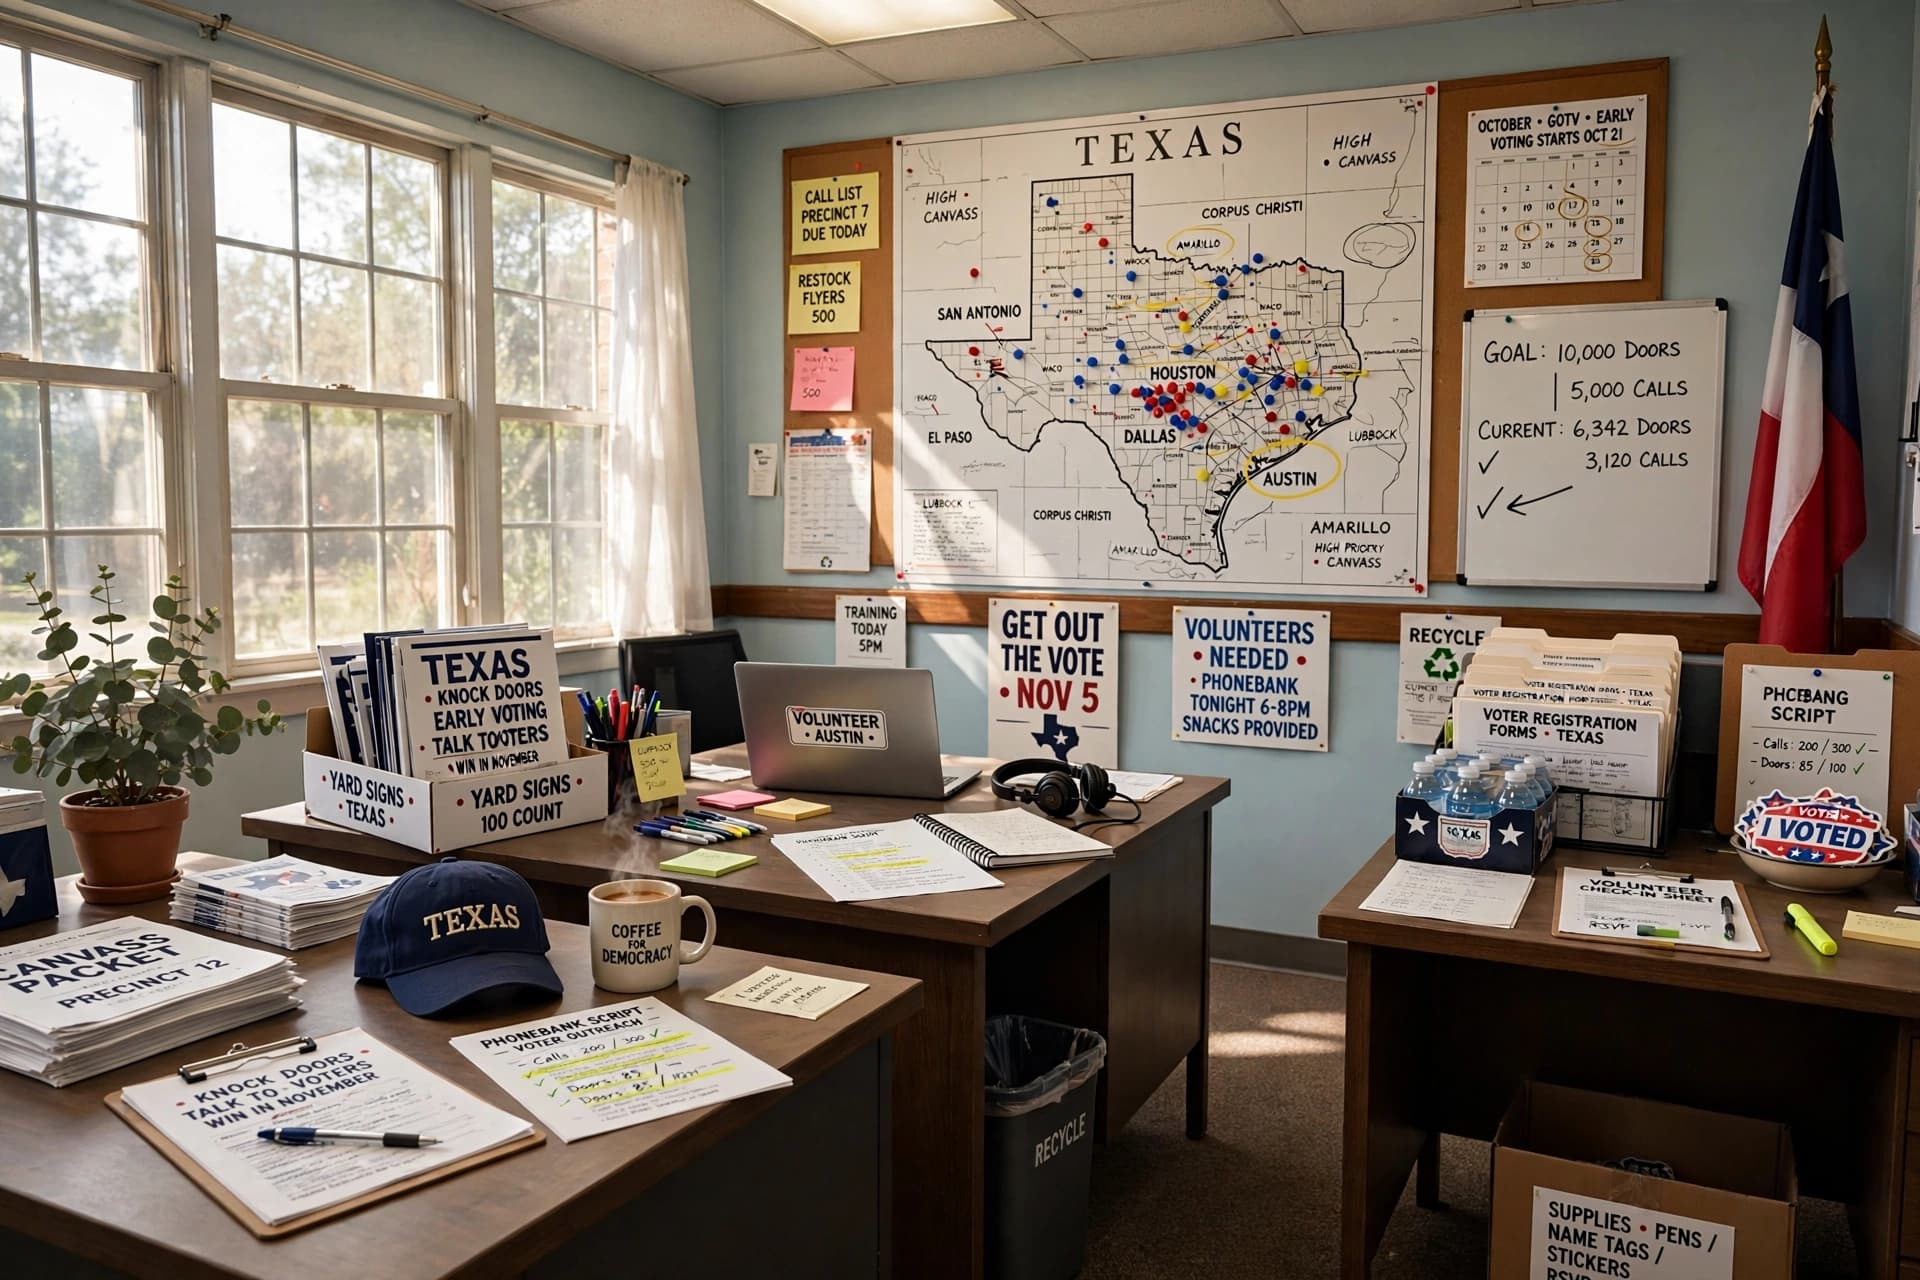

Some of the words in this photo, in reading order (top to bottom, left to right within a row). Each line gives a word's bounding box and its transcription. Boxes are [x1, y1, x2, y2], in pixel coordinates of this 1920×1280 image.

[1478, 116, 1532, 133] OCTOBER
[1548, 112, 1580, 128] GOTV
[1596, 108, 1634, 124] EARLY
[1075, 121, 1243, 167] TEXAS
[1333, 132, 1372, 150] HIGH
[1490, 134, 1534, 150] VOTING
[1537, 131, 1580, 148] STARTS
[1584, 130, 1606, 144] OCT
[1610, 128, 1622, 141] 21
[1338, 152, 1396, 168] CANVASS
[806, 188, 833, 204] CALL
[838, 186, 862, 201] LIST
[926, 190, 956, 206] HIGH
[801, 206, 858, 223] PRECINCT
[860, 204, 868, 218] 7
[924, 208, 978, 224] CANVASS
[1202, 204, 1250, 220] CORPUS
[1256, 200, 1304, 216] CHRISTI
[802, 226, 826, 242] DUE
[828, 223, 868, 239] TODAY
[1176, 238, 1220, 250] AMARILLO
[1520, 261, 1531, 269] 30
[798, 272, 850, 288] RESTOCK
[802, 290, 844, 306] FLYERS
[812, 308, 836, 324] 500
[938, 306, 962, 320] SAN
[966, 304, 1022, 320] ANTONIO
[1484, 340, 1546, 364] GOAL:
[1558, 342, 1616, 365] 10,000
[1624, 340, 1680, 360] DOORS
[1150, 364, 1216, 380] HOUSTON
[1570, 380, 1625, 402] 5,000
[1633, 378, 1688, 398] CALLS
[928, 432, 941, 444] EL
[944, 431, 972, 444] PASO
[1124, 428, 1176, 444] DALLAS
[1348, 430, 1398, 442] LUBBOCK
[1478, 420, 1564, 440] CURRENT:
[1572, 418, 1630, 441] 6,342
[1637, 418, 1692, 436] DOORS
[1585, 451, 1632, 473] 3,120
[1640, 450, 1688, 468] CALLS
[1262, 471, 1318, 486] AUSTIN
[1033, 510, 1072, 520] CORPUS
[1074, 510, 1112, 521] CHRISTI
[1310, 520, 1391, 534] AMARILLO
[1314, 542, 1342, 553] HIGH
[1327, 557, 1382, 568] CANVASS
[844, 606, 898, 620] TRAINING
[852, 622, 888, 636] TODAY
[1002, 609, 1048, 640] GET
[1054, 610, 1105, 643] OUT
[1184, 617, 1315, 646] VOLUNTEERS
[858, 640, 883, 654] 5PM
[1409, 627, 1486, 647] RECYCLE
[420, 648, 530, 686] TEXAS
[1000, 643, 1042, 673] THE
[1047, 646, 1104, 677] VOTE
[1209, 645, 1290, 671] NEEDED
[438, 686, 490, 706] KNOCK
[494, 681, 544, 702] DOORS
[1202, 673, 1299, 696] PHONEBANK
[1017, 677, 1073, 712] NOV
[1080, 681, 1099, 714] 5
[1190, 694, 1256, 715] TONIGHT
[1260, 697, 1311, 718] 6-8PM
[434, 708, 485, 732] EARLY
[492, 701, 548, 724] VOTING
[792, 710, 880, 730] VOLUNTEER
[1483, 707, 1529, 724] VOTER
[1533, 713, 1638, 732] REGISTRATION
[1771, 706, 1836, 724] SCRIPT
[815, 728, 864, 745] AUSTIN
[1182, 715, 1240, 736] SNACKS
[1244, 719, 1318, 740] PROVIDED
[1489, 724, 1538, 740] FORMS
[1556, 729, 1604, 745] TEXAS
[432, 734, 475, 756] TALK
[1798, 741, 1819, 752] 200
[1832, 743, 1852, 754] 300
[455, 758, 476, 775] WIN
[478, 757, 489, 772] IN
[1800, 760, 1814, 772] 85
[1830, 762, 1846, 774] 100
[329, 769, 362, 796] YARD
[366, 780, 404, 808] SIGNS
[470, 784, 518, 810] YARD
[522, 774, 572, 799] SIGNS
[346, 799, 386, 828] TEXAS
[481, 813, 508, 834] 100
[512, 801, 564, 828] COUNT
[1760, 818, 1772, 836] I
[1780, 818, 1868, 850] VOTED
[1580, 884, 1656, 899] CHECK-IN
[1664, 892, 1716, 904] SHEET
[1590, 878, 1704, 896] VOLUNTEER
[422, 903, 521, 942] TEXAS
[612, 922, 662, 939] COFFEE
[628, 938, 647, 950] FOR
[602, 944, 673, 966] DEMOCRACY
[8, 945, 181, 994] PACKET
[57, 968, 190, 1009] PRECINCT
[194, 958, 230, 971] 12
[479, 1016, 587, 1050] PHONEBANK
[588, 1006, 644, 1027] SCRIPT
[512, 1035, 564, 1053] VOTER
[568, 1018, 644, 1042] OUTREACH
[194, 1074, 272, 1104] KNOCK
[280, 1052, 356, 1080] DOORS
[182, 1098, 242, 1122] TALK
[246, 1086, 280, 1104] TO
[290, 1060, 374, 1090] VOTERS
[202, 1111, 248, 1130] WIN
[252, 1100, 276, 1116] IN
[276, 1070, 380, 1109] NOVEMBER
[1034, 1112, 1087, 1168] RECYCLE
[1548, 1200, 1632, 1234] SUPPLIES
[1655, 1222, 1702, 1249] PENS
[1548, 1222, 1598, 1250] NAME
[1604, 1234, 1650, 1261] TAGS
[1547, 1246, 1630, 1279] STICKERS
